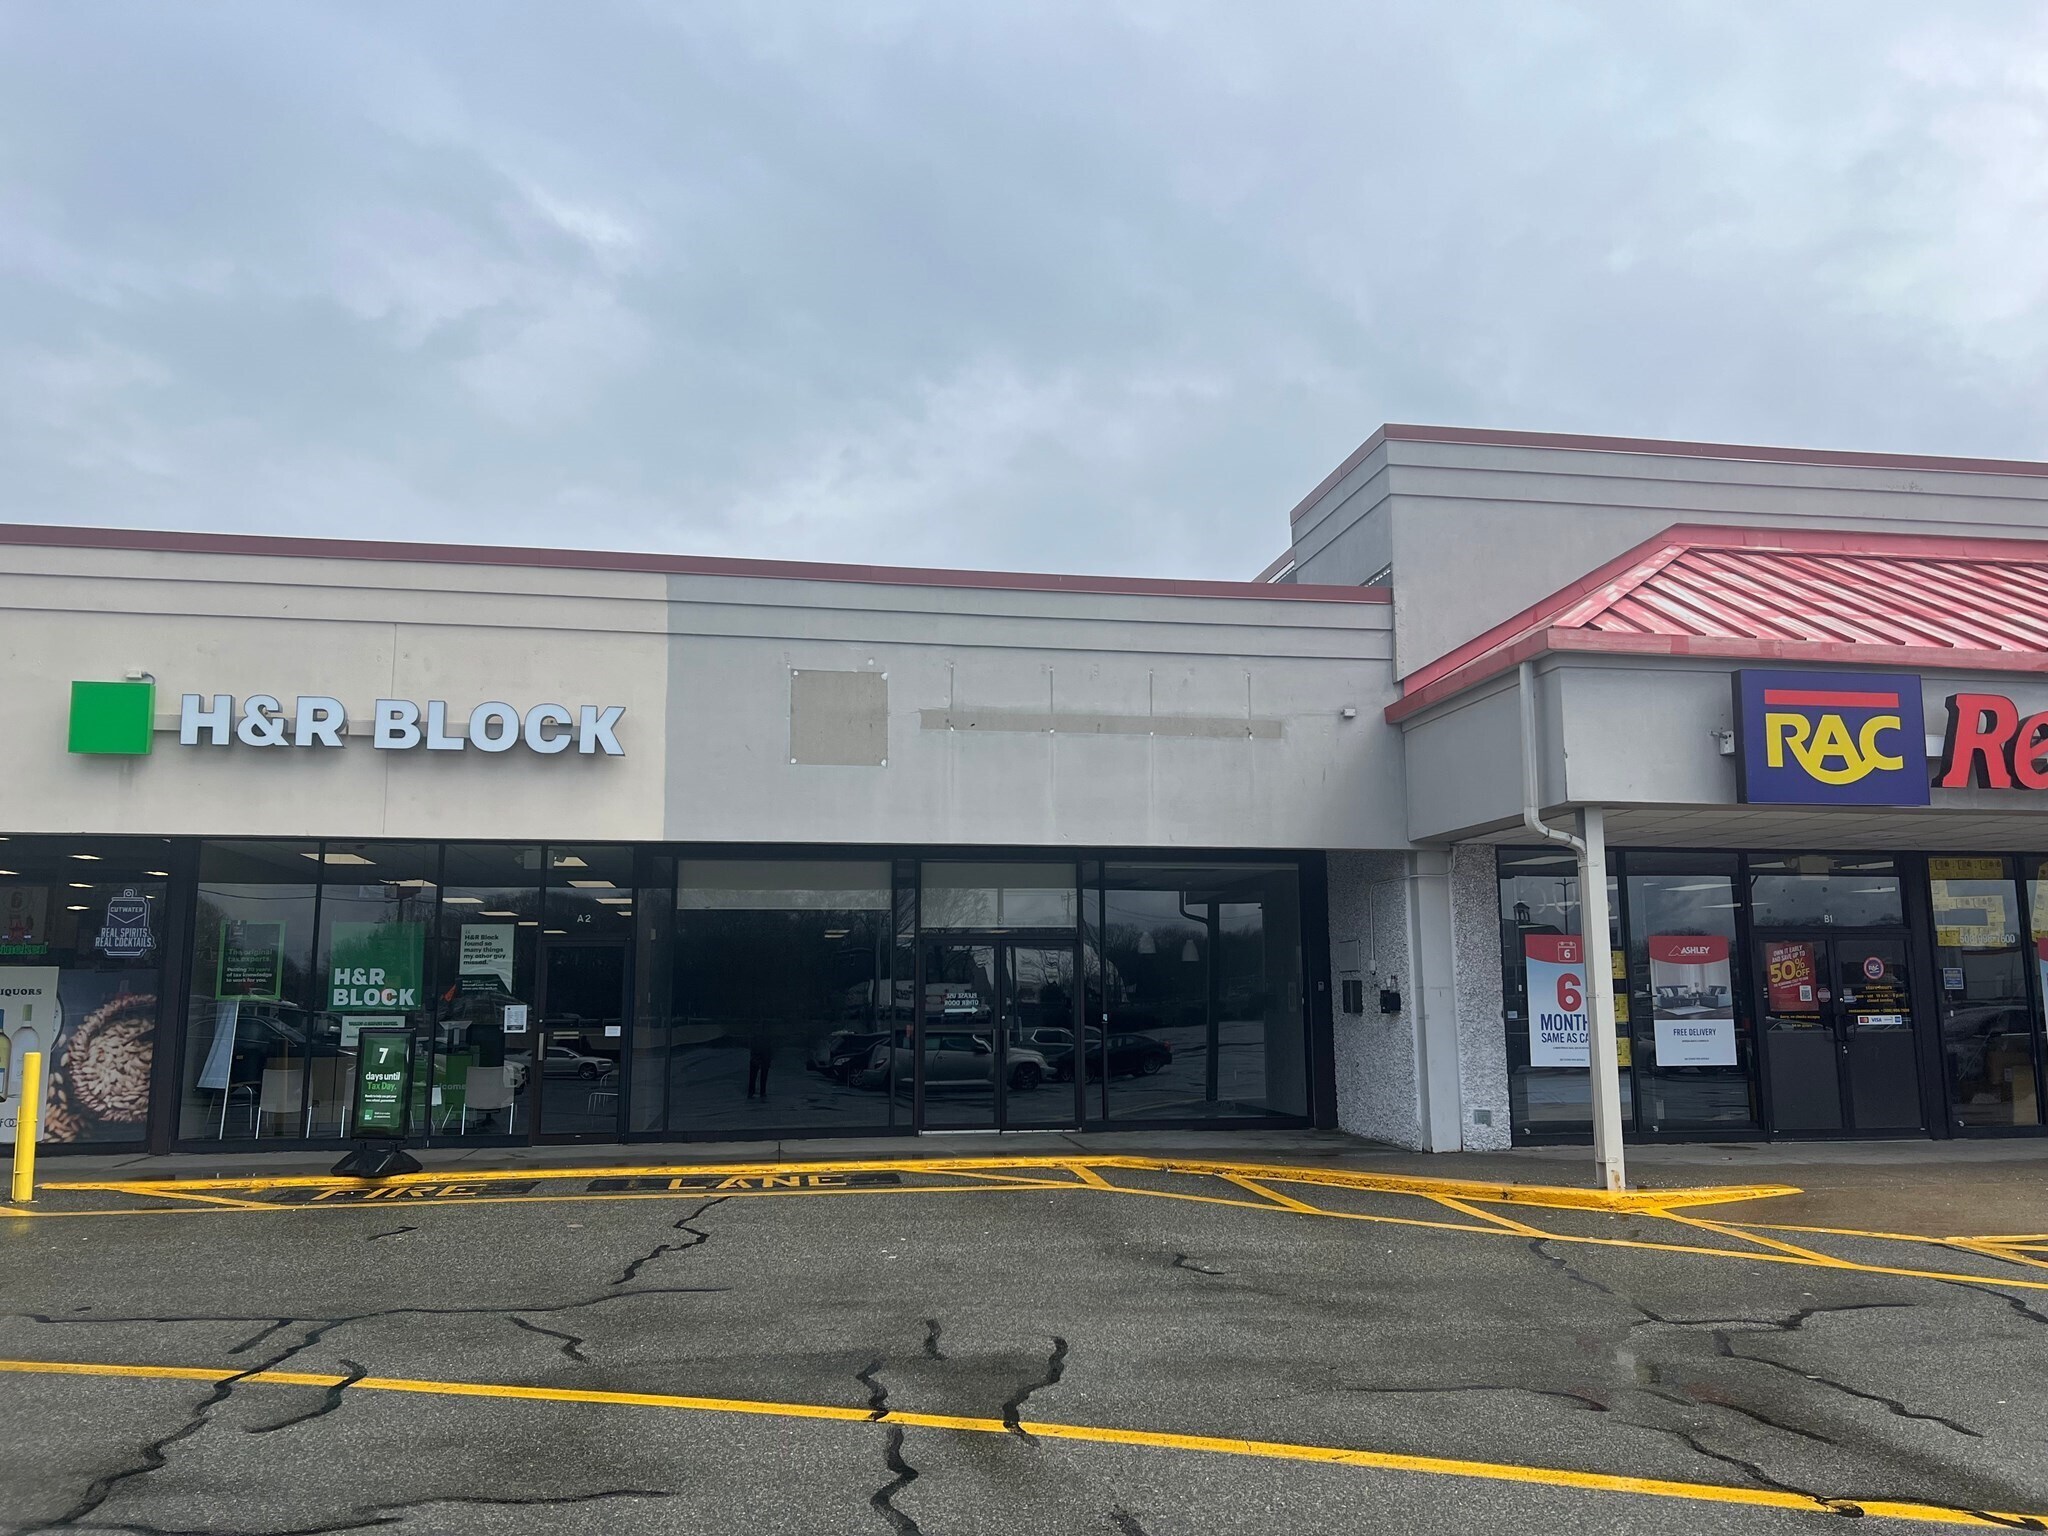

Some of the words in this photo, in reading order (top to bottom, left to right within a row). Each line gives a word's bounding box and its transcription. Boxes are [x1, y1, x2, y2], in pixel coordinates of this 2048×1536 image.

[179, 694, 346, 748] H&R
[373, 698, 626, 756] BLOCK
[1765, 712, 1904, 785] RAC
[576, 914, 592, 923] A2
[1824, 914, 1833, 923] B1
[101, 928, 118, 937] REAL
[120, 928, 148, 937] SPIRITS.
[95, 937, 112, 947] REAL
[114, 937, 154, 947] COCKTAILS.
[1564, 949, 1571, 959] 6
[334, 968, 385, 985] H&R
[1796, 968, 1810, 978] OFF
[333, 988, 415, 1006] BLOCK
[1556, 973, 1581, 1012] 6
[1540, 1014, 1587, 1031] MONTH
[1673, 1028, 1688, 1036] FREE
[1689, 1028, 1716, 1036] DELIVERY
[1541, 1032, 1565, 1043] SAME
[1567, 1032, 1577, 1043] AS
[378, 1047, 389, 1064] 7
[365, 1072, 383, 1082] days
[384, 1072, 401, 1080] until
[367, 1082, 380, 1090] Tax
[381, 1082, 397, 1091] Day.
[310, 1184, 488, 1200] FIRE
[668, 1174, 848, 1190] LANE
